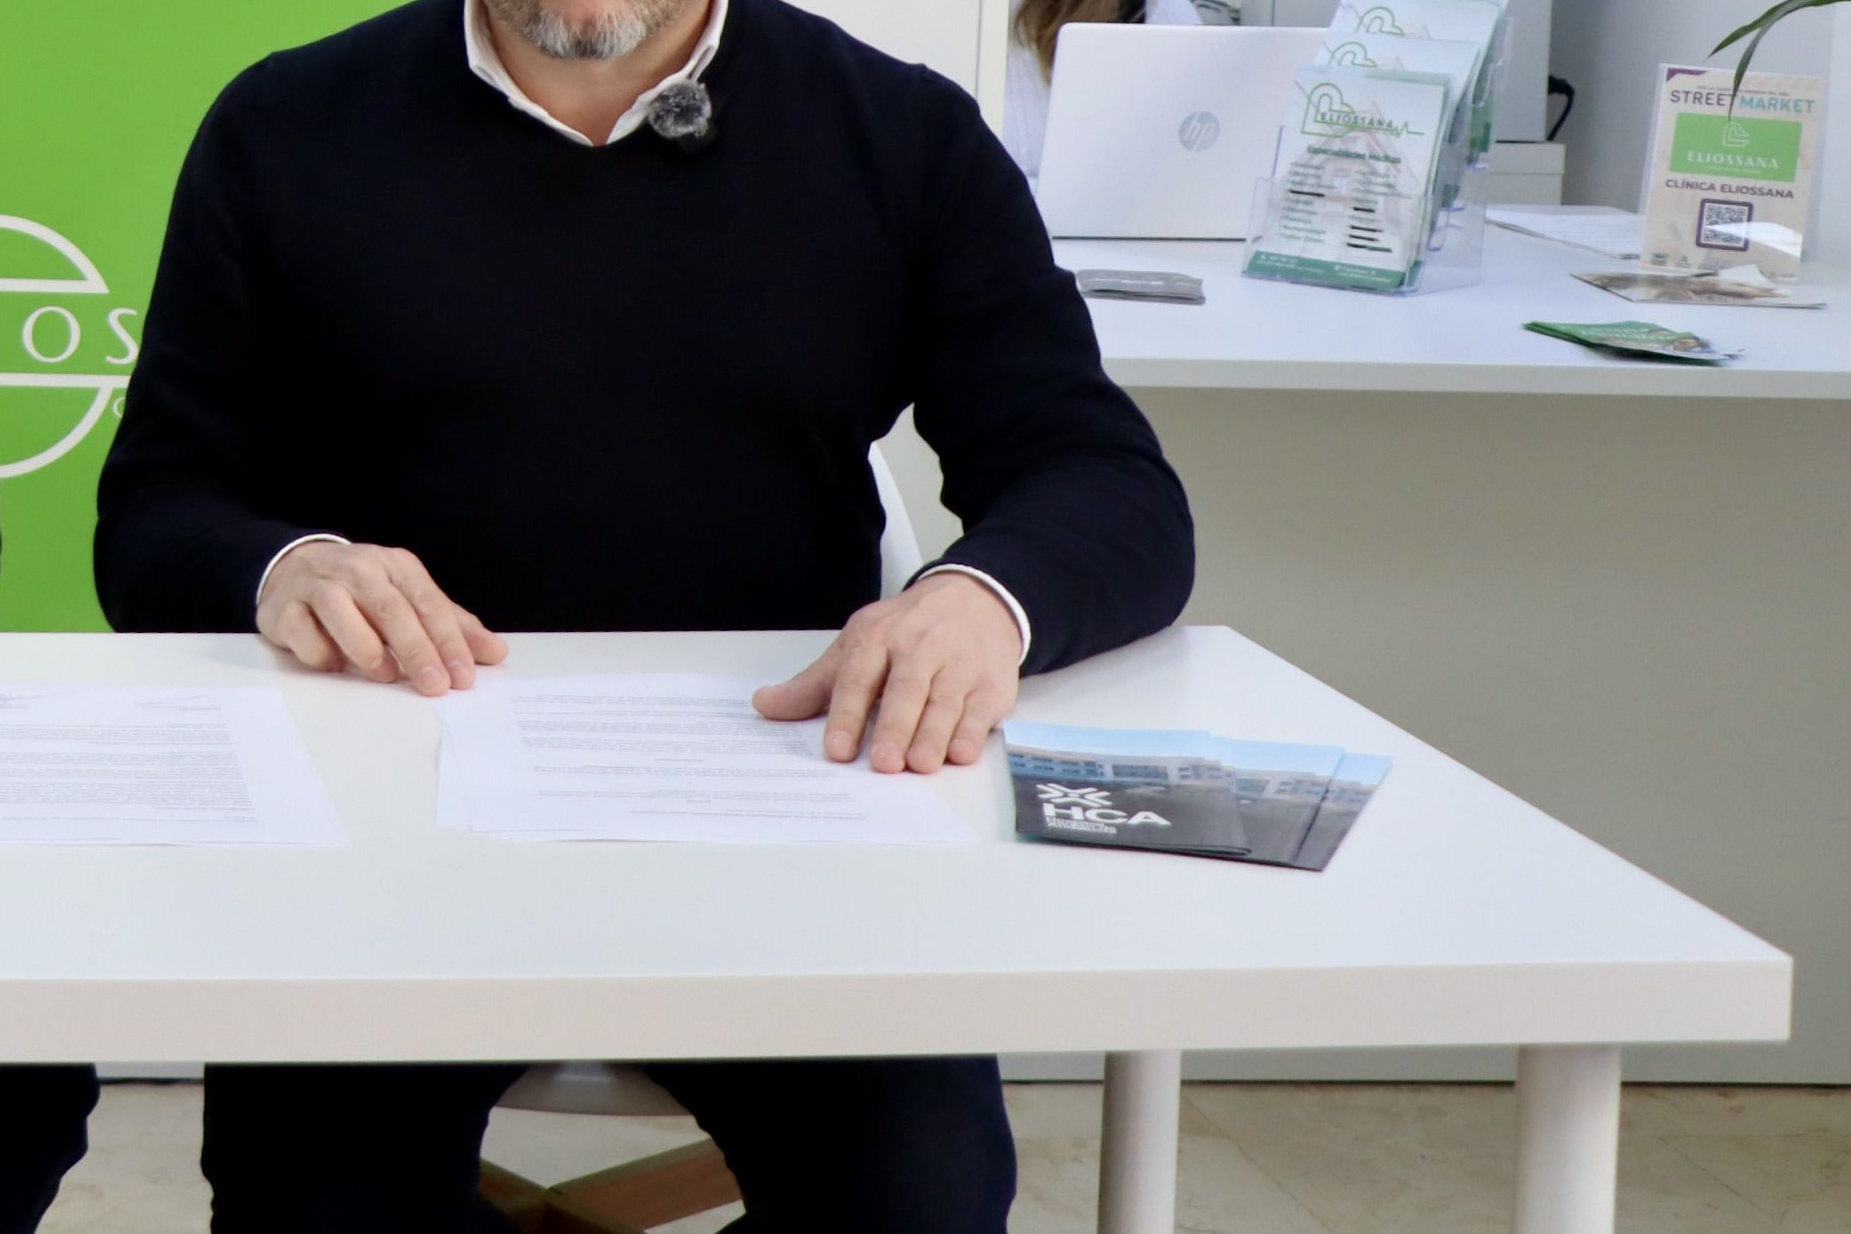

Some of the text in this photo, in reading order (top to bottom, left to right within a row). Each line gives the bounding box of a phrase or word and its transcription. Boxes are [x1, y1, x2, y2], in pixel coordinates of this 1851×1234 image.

[1739, 95, 1815, 113] MARKET
[1687, 150, 1779, 170] ELIOSSANA
[1719, 183, 1795, 200] ELIOSSANA
[1042, 802, 1172, 826] HCA
